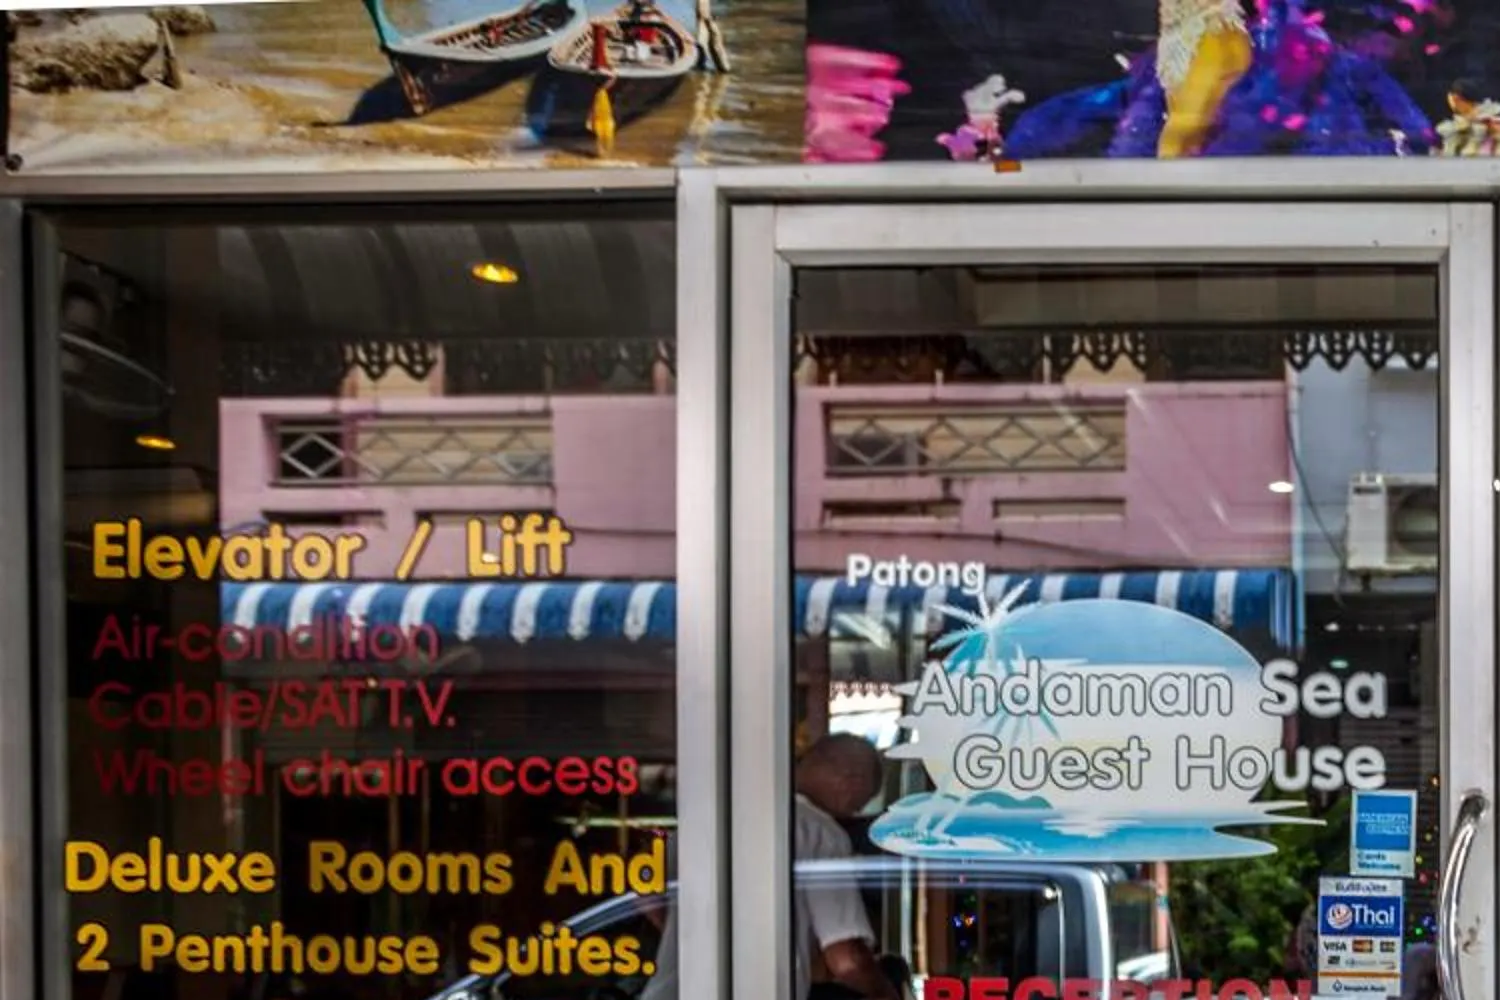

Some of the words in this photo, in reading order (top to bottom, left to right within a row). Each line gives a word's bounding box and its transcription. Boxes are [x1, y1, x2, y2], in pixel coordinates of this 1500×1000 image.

[91, 518, 365, 581] Elevator
[466, 513, 571, 577] Lift
[846, 554, 986, 593] Patong
[92, 615, 439, 662] Air-condition
[90, 680, 365, 730] Cable/SAT
[384, 680, 455, 727] T.V.
[911, 657, 1233, 718] Andaman
[1260, 659, 1387, 718] Sea
[96, 750, 264, 795] Wheel
[282, 752, 425, 795] chair
[442, 755, 639, 795] access
[953, 734, 1151, 790] Guest
[1176, 734, 1386, 790] House
[65, 837, 275, 894] Deluxe
[309, 840, 512, 894] Rooms
[543, 835, 666, 896] And
[75, 924, 110, 972] 2
[140, 922, 439, 974] Penthouse
[469, 924, 656, 976] Suites.
